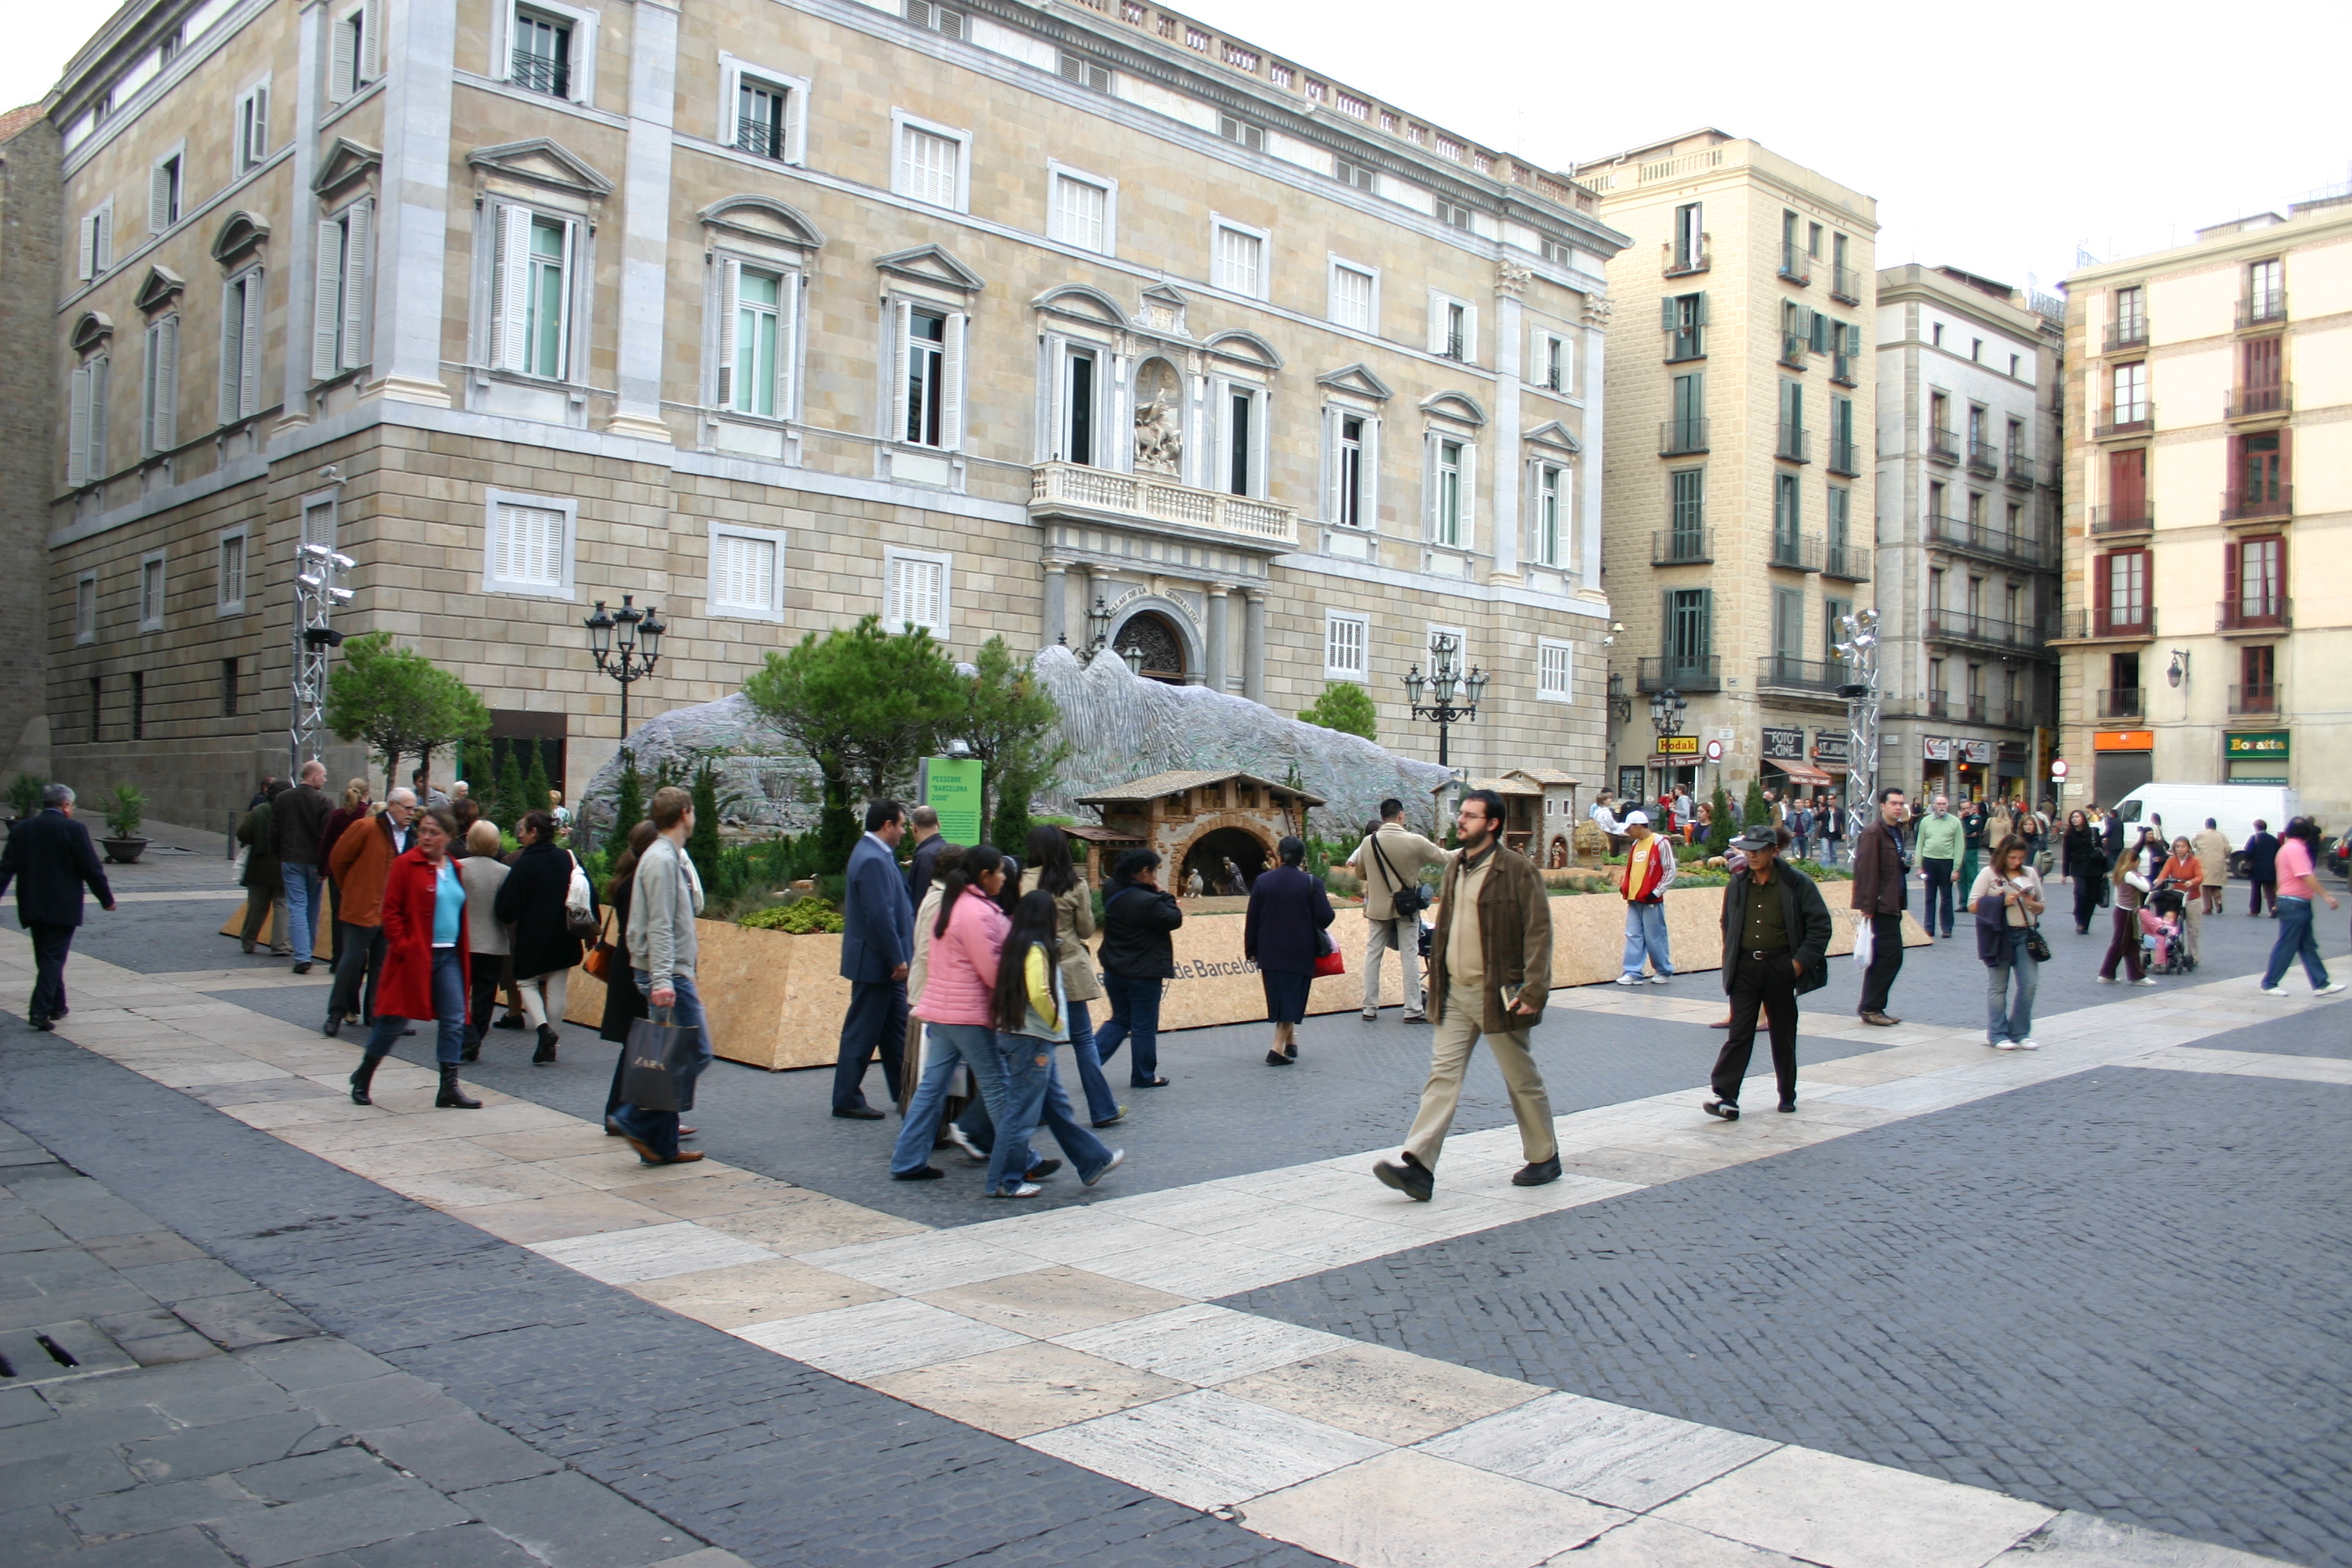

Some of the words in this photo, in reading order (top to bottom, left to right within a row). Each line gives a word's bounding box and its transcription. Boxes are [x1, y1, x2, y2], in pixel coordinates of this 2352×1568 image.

[1109, 593, 1128, 616] PALAU
[1129, 589, 1138, 599] DE
[1138, 586, 1148, 596] LA
[1165, 590, 1200, 626] GENERALITAT
[1661, 740, 1694, 750] Kodak
[1772, 731, 1794, 745] FOTO
[1172, 961, 1194, 980] de
[634, 1057, 666, 1071] ZARA
